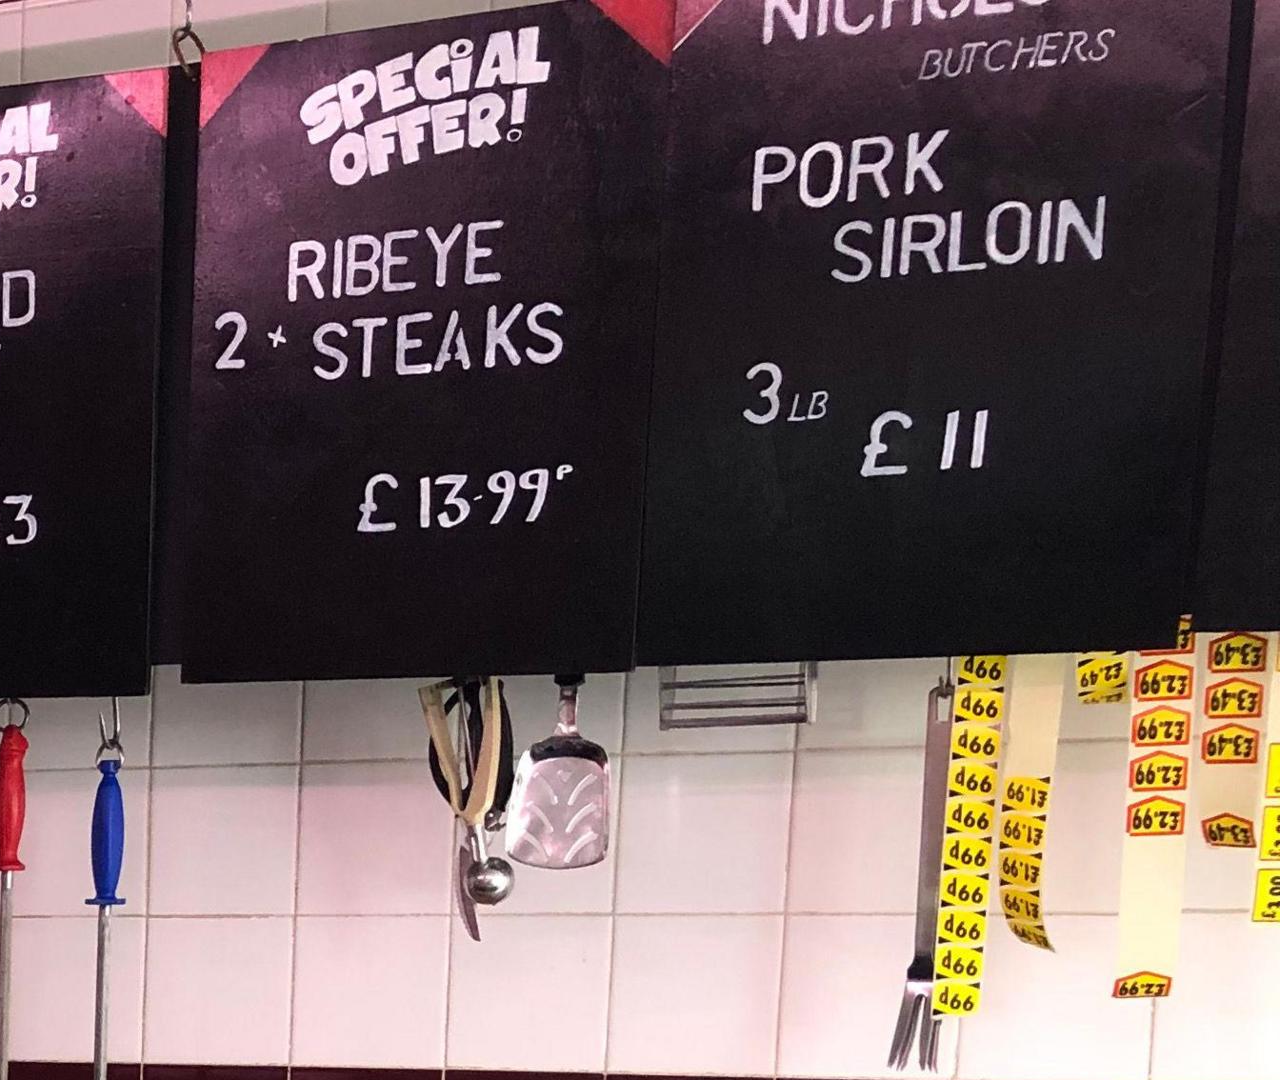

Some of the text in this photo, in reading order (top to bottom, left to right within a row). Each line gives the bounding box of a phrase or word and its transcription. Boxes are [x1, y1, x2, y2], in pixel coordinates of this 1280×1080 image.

[919, 28, 1116, 81] BUTCHERS
[329, 86, 528, 186] OFFER!
[751, 129, 950, 212] PORK
[831, 196, 1107, 283] SIRLOIN
[288, 219, 505, 302] RIBEYE
[312, 302, 564, 380] STEAKS
[1214, 643, 1262, 666] £3.49
[964, 656, 1001, 680] 99p
[1080, 662, 1123, 688] £2.49
[1140, 672, 1188, 695] £2.99
[961, 691, 998, 718] 99p
[1210, 688, 1259, 712] £3.49
[958, 729, 995, 755] 99p
[1137, 718, 1185, 741] £2.99
[1207, 734, 1254, 758] £3.49
[955, 766, 992, 793] 99p
[1135, 763, 1182, 786] £2.99
[1007, 782, 1048, 808] £1.99
[952, 803, 989, 830] 99p
[1132, 808, 1180, 830] £2.99
[1004, 819, 1043, 846] £1.99
[949, 840, 986, 867] 99p
[1003, 857, 1040, 883] £1.99
[947, 878, 983, 904] 99p
[944, 914, 980, 940] 99p
[941, 950, 978, 976] 99p
[939, 986, 974, 1011] 99p
